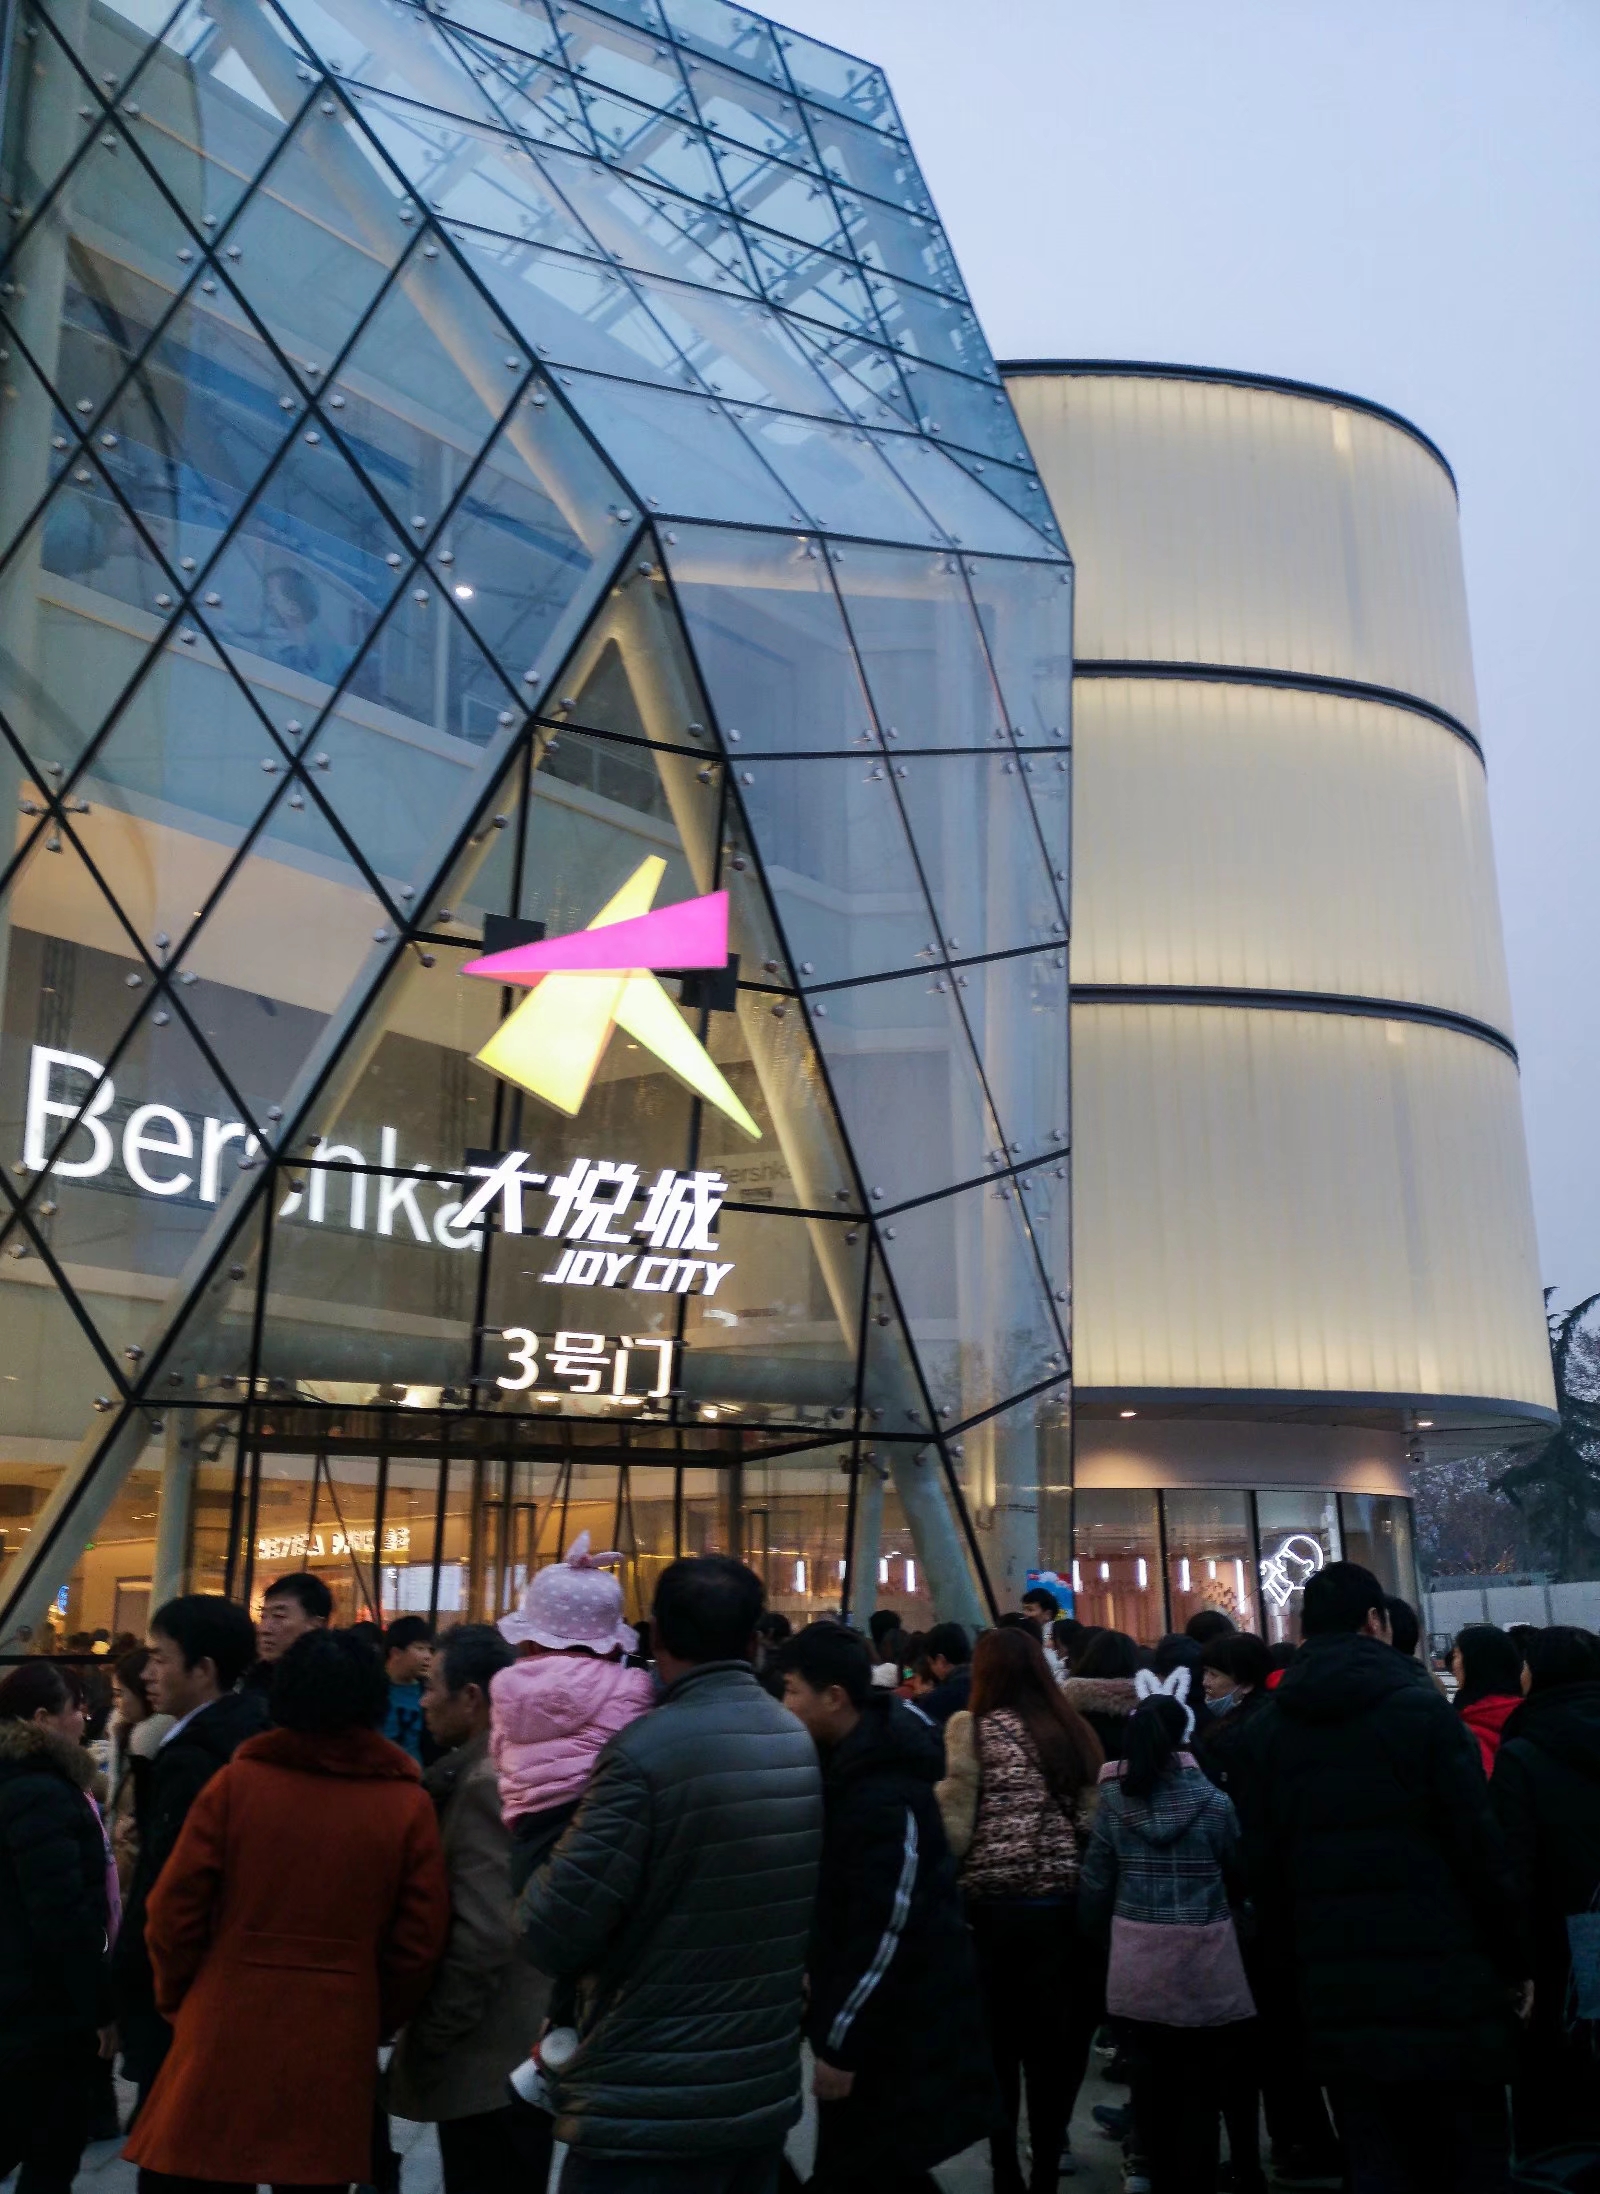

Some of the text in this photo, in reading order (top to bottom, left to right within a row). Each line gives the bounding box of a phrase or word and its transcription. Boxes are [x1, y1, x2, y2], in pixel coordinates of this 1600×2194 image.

[450, 1151, 729, 1251] 大悦城
[541, 1249, 736, 1296] JOY CITY
[495, 1327, 674, 1398] 3号门
